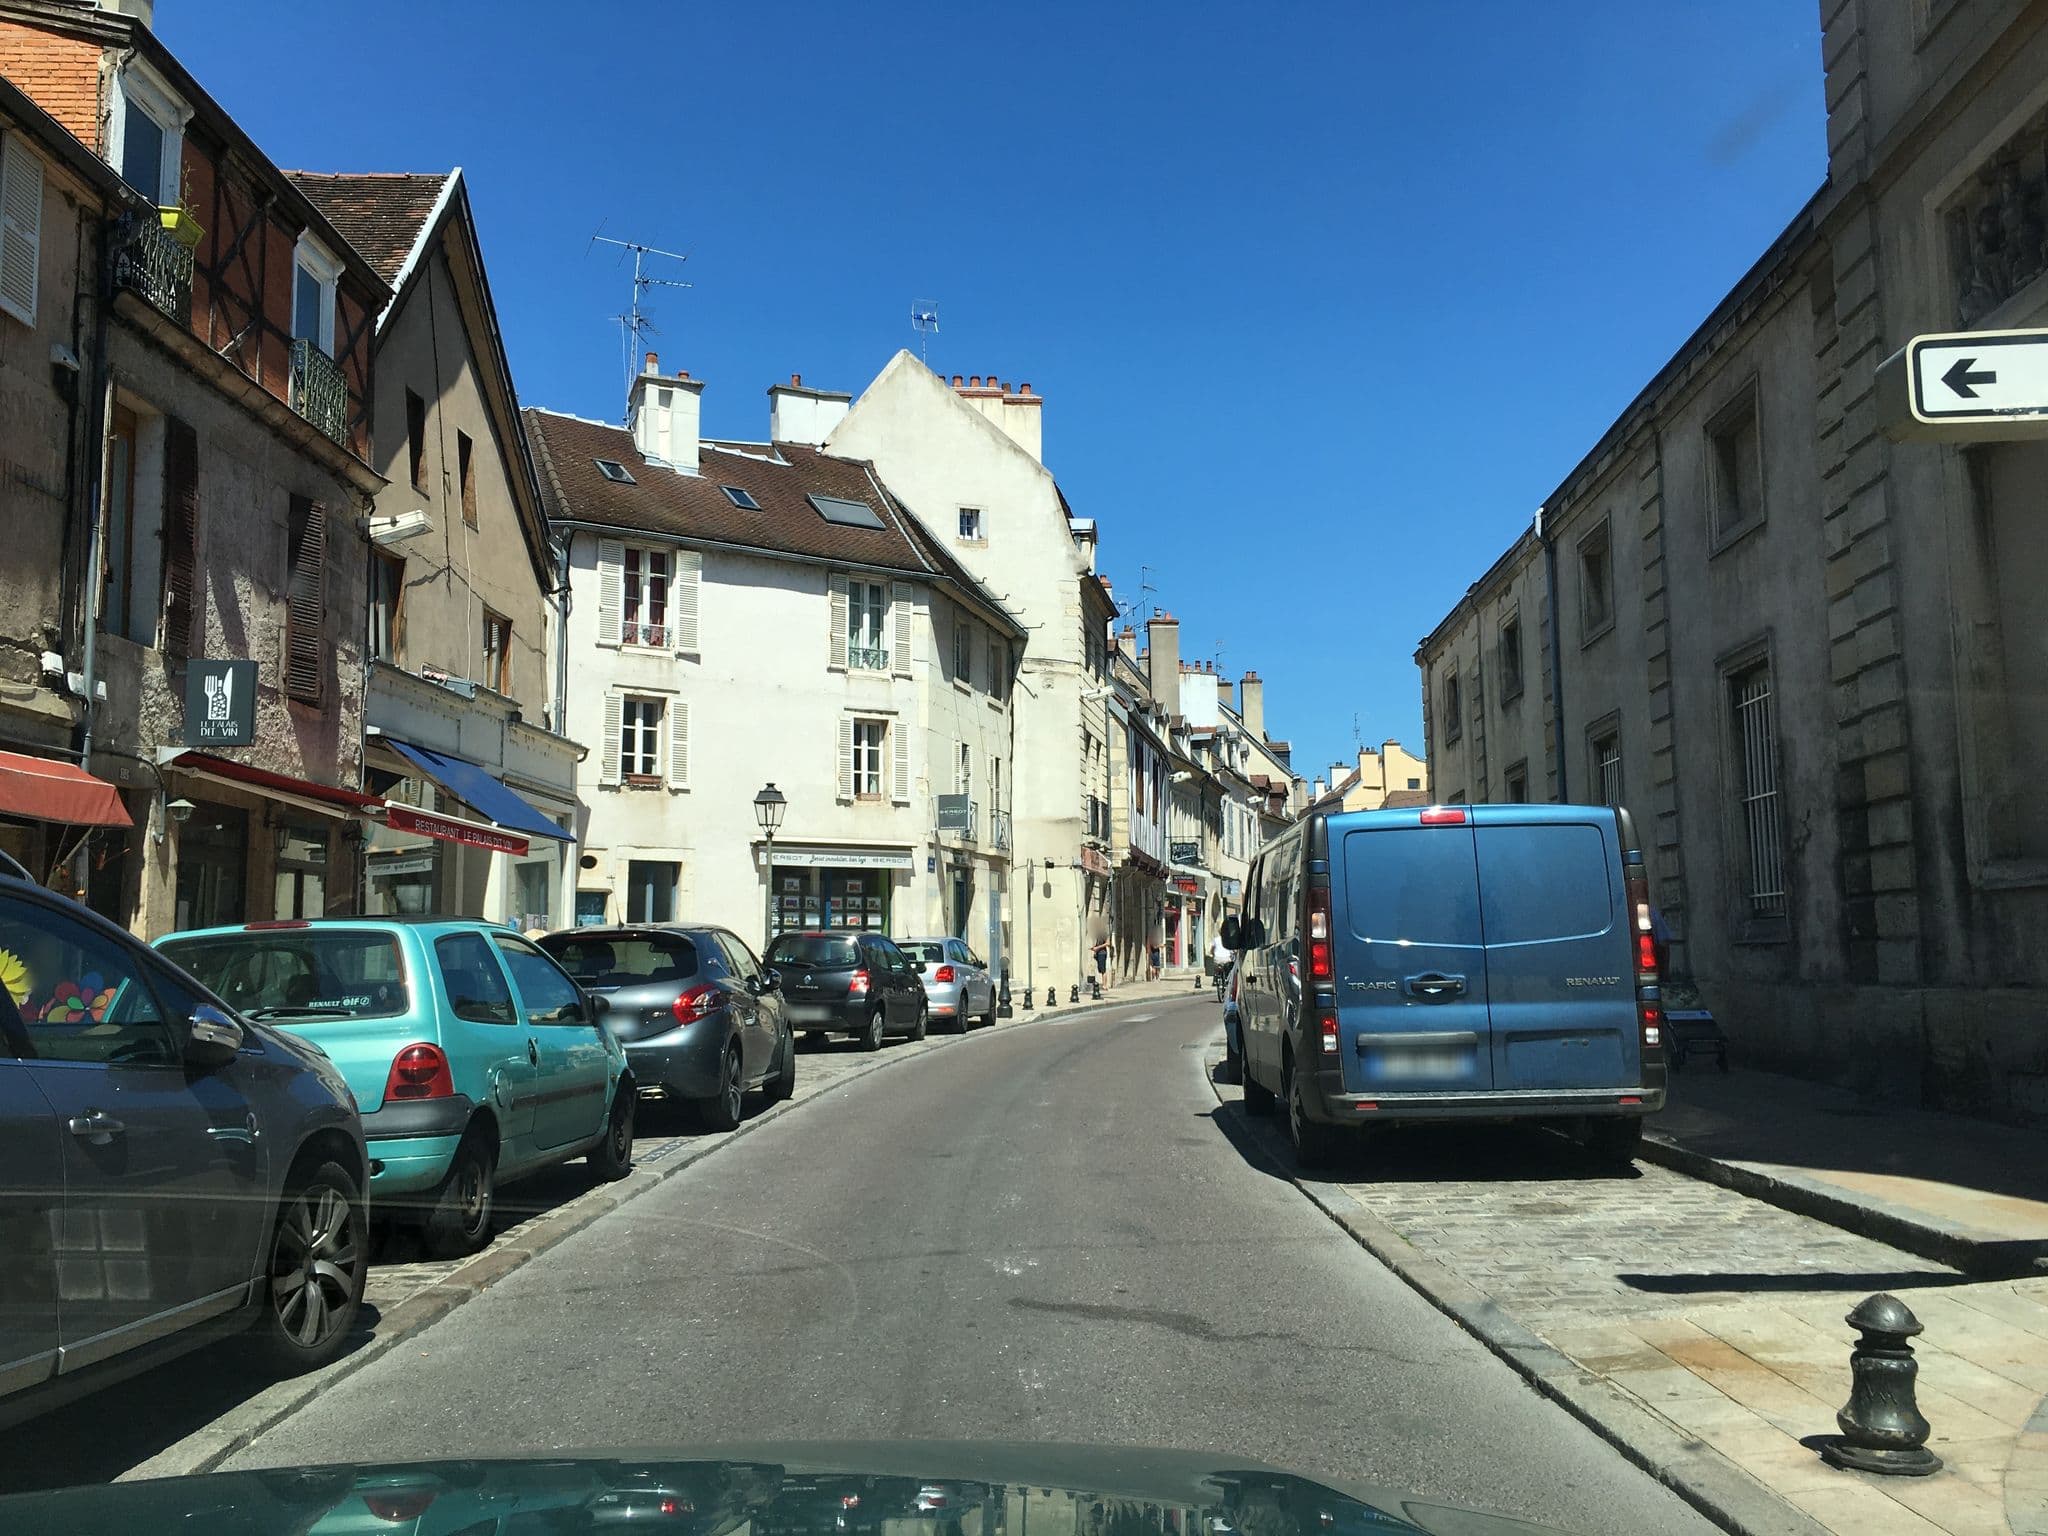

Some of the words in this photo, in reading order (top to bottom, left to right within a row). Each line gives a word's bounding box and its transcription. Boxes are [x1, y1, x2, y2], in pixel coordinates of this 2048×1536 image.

[200, 728, 215, 736] DIT
[222, 728, 238, 736] VIN
[415, 819, 460, 840] RESTAURANT
[463, 829, 472, 842] LE
[472, 832, 493, 847] PALAIS
[493, 837, 503, 849] DIT
[503, 839, 513, 851] VIN
[1347, 980, 1397, 991] TRAFIC
[1565, 975, 1621, 987] RENAULT
[309, 1000, 340, 1008] RENAULT
